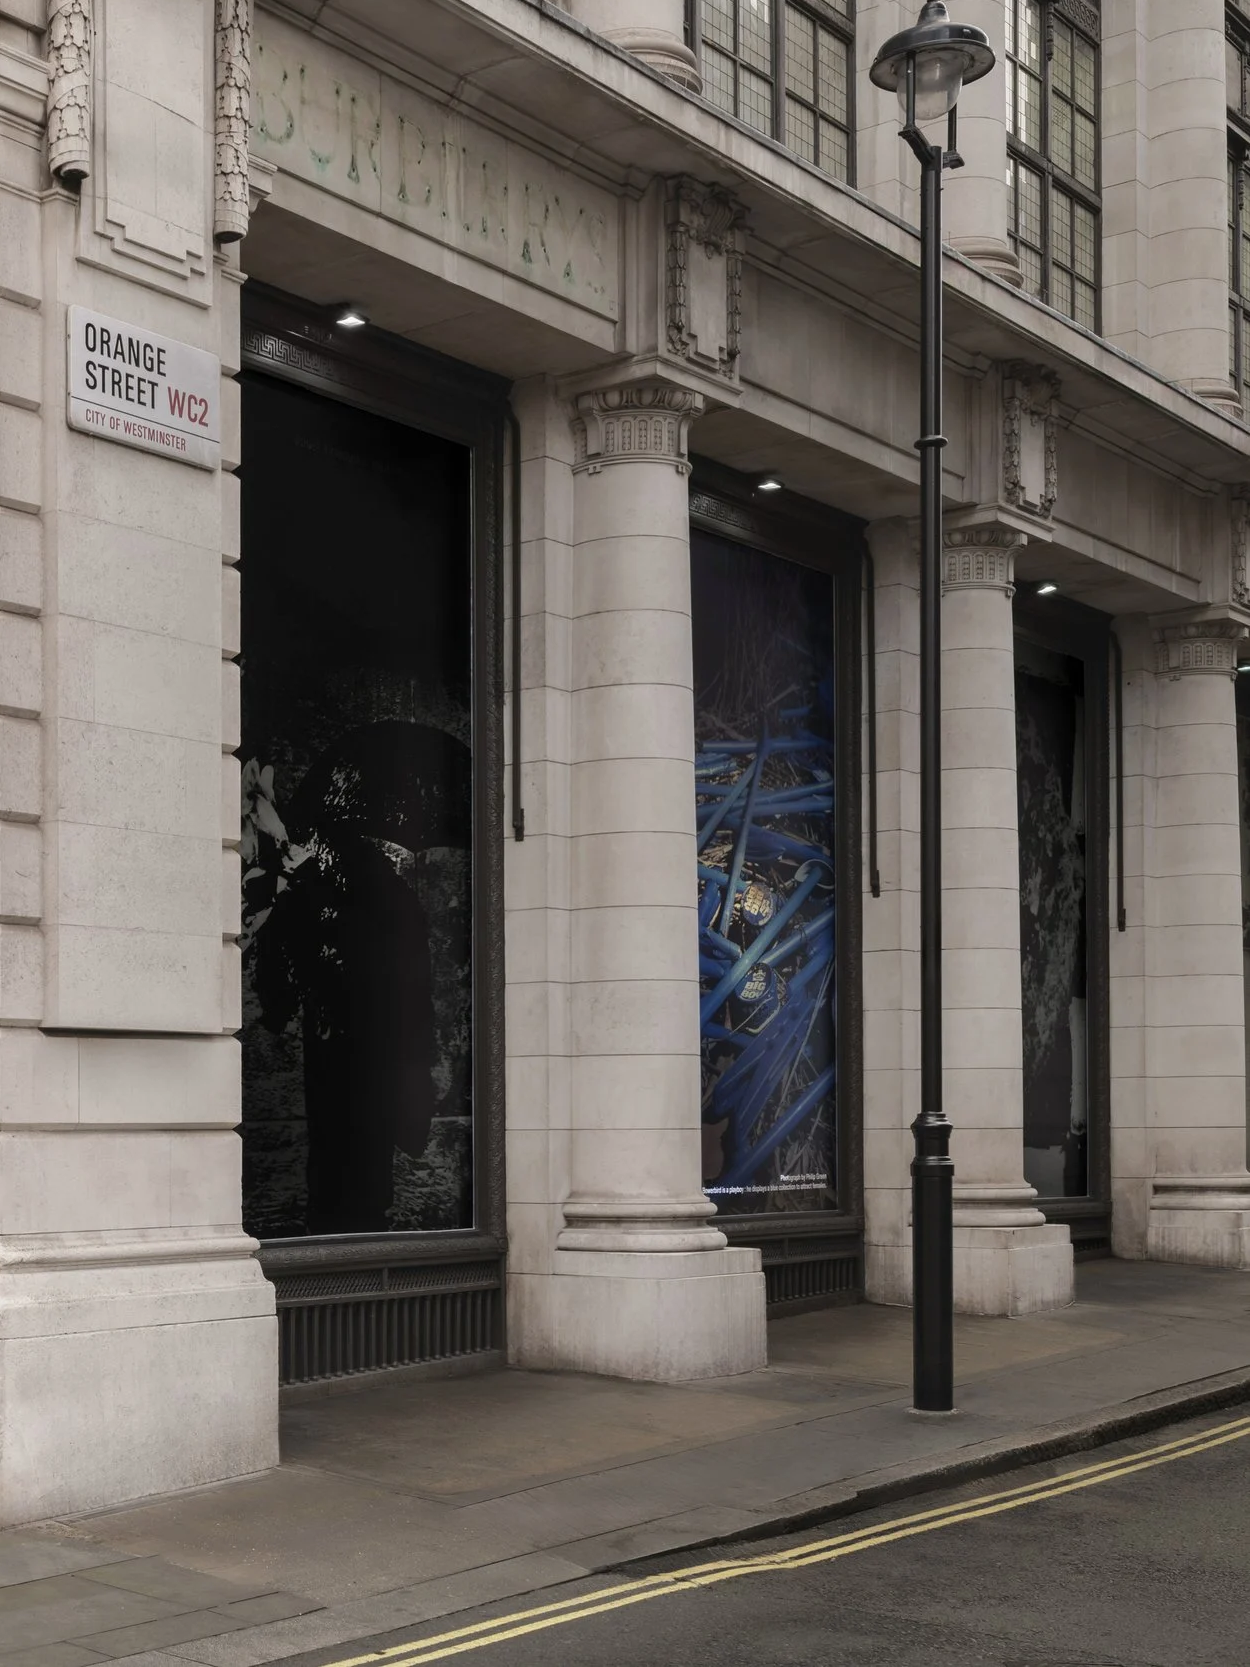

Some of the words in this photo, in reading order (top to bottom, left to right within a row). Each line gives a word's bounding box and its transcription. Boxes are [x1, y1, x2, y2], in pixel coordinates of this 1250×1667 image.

[85, 322, 166, 377] ORANGE
[86, 360, 158, 409] STREET
[168, 386, 208, 428] WC2
[86, 409, 106, 427] CITY
[109, 416, 121, 430] OF
[123, 420, 186, 452] WESTMINSTER
